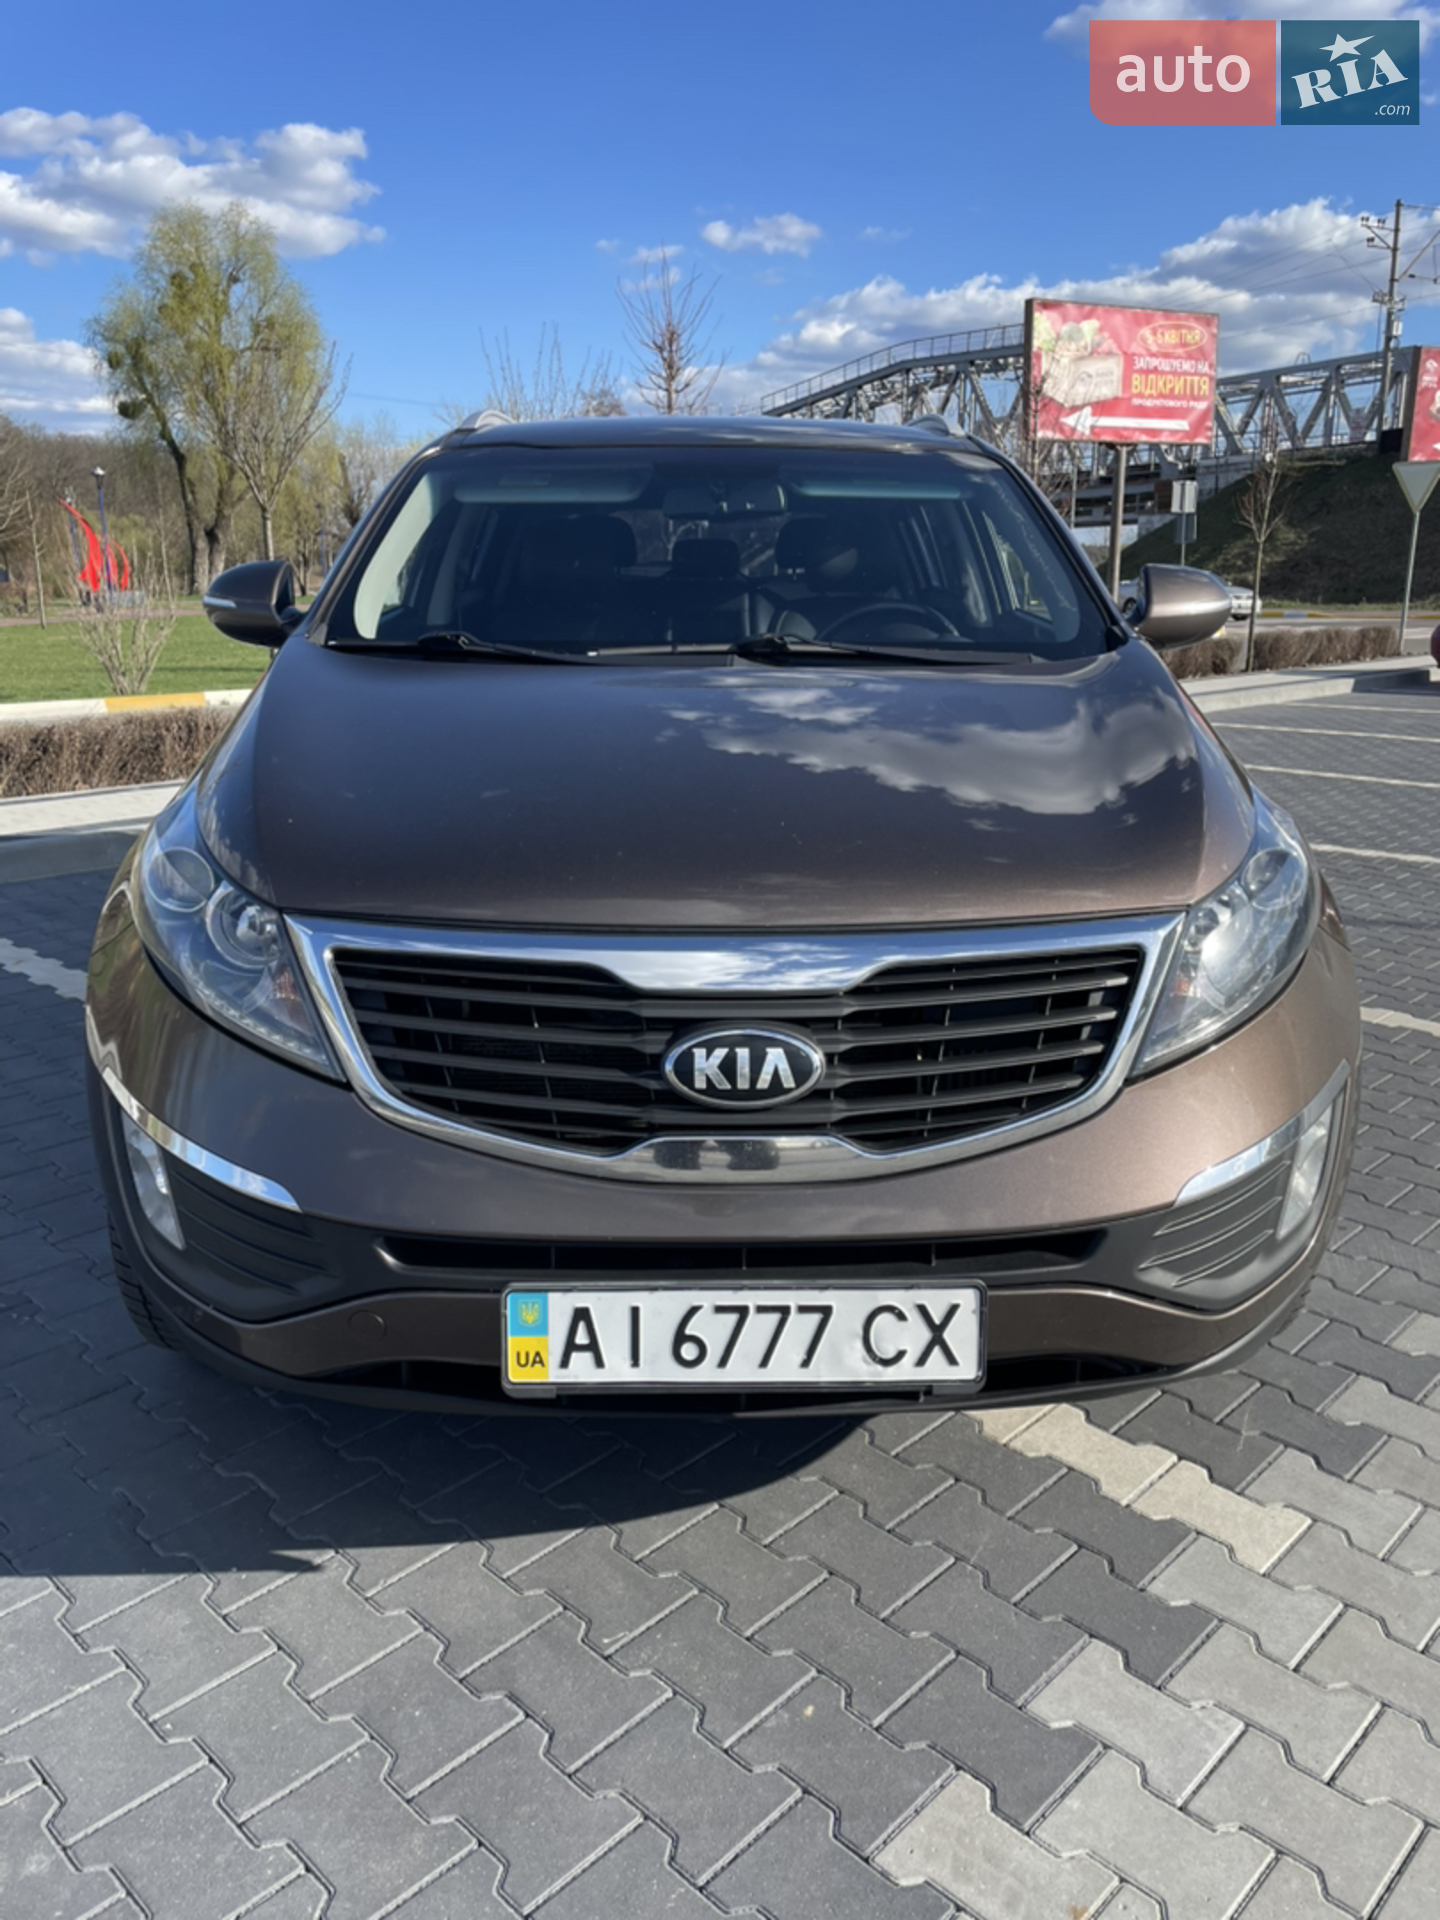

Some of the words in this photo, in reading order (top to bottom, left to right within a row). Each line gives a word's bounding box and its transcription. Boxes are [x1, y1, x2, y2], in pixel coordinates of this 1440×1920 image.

[1131, 373, 1210, 397] ВІДКРИТТЯ
[692, 1047, 796, 1090] KIA
[559, 1304, 641, 1369] AI
[672, 1304, 834, 1369] 6777
[862, 1304, 962, 1368] CX
[515, 1350, 546, 1368] UA
